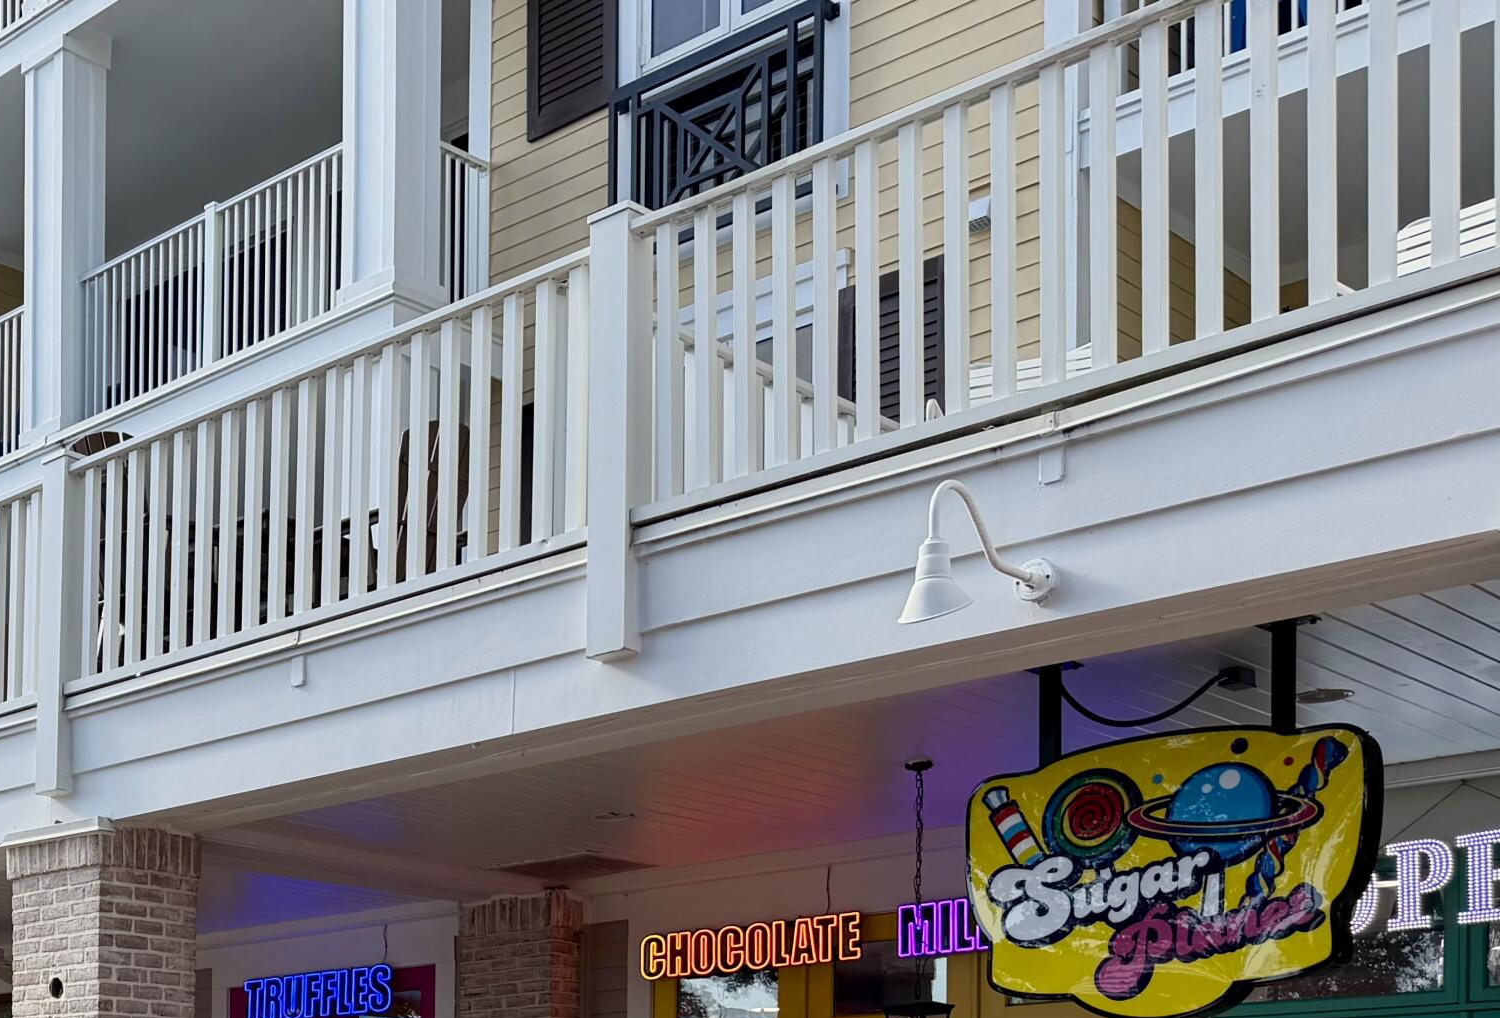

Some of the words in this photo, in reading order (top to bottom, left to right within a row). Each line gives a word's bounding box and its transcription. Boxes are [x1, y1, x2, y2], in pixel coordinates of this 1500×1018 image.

[989, 849, 1211, 943] Sugar
[1349, 828, 1500, 936] PE
[640, 911, 862, 981] CHOCOLATE
